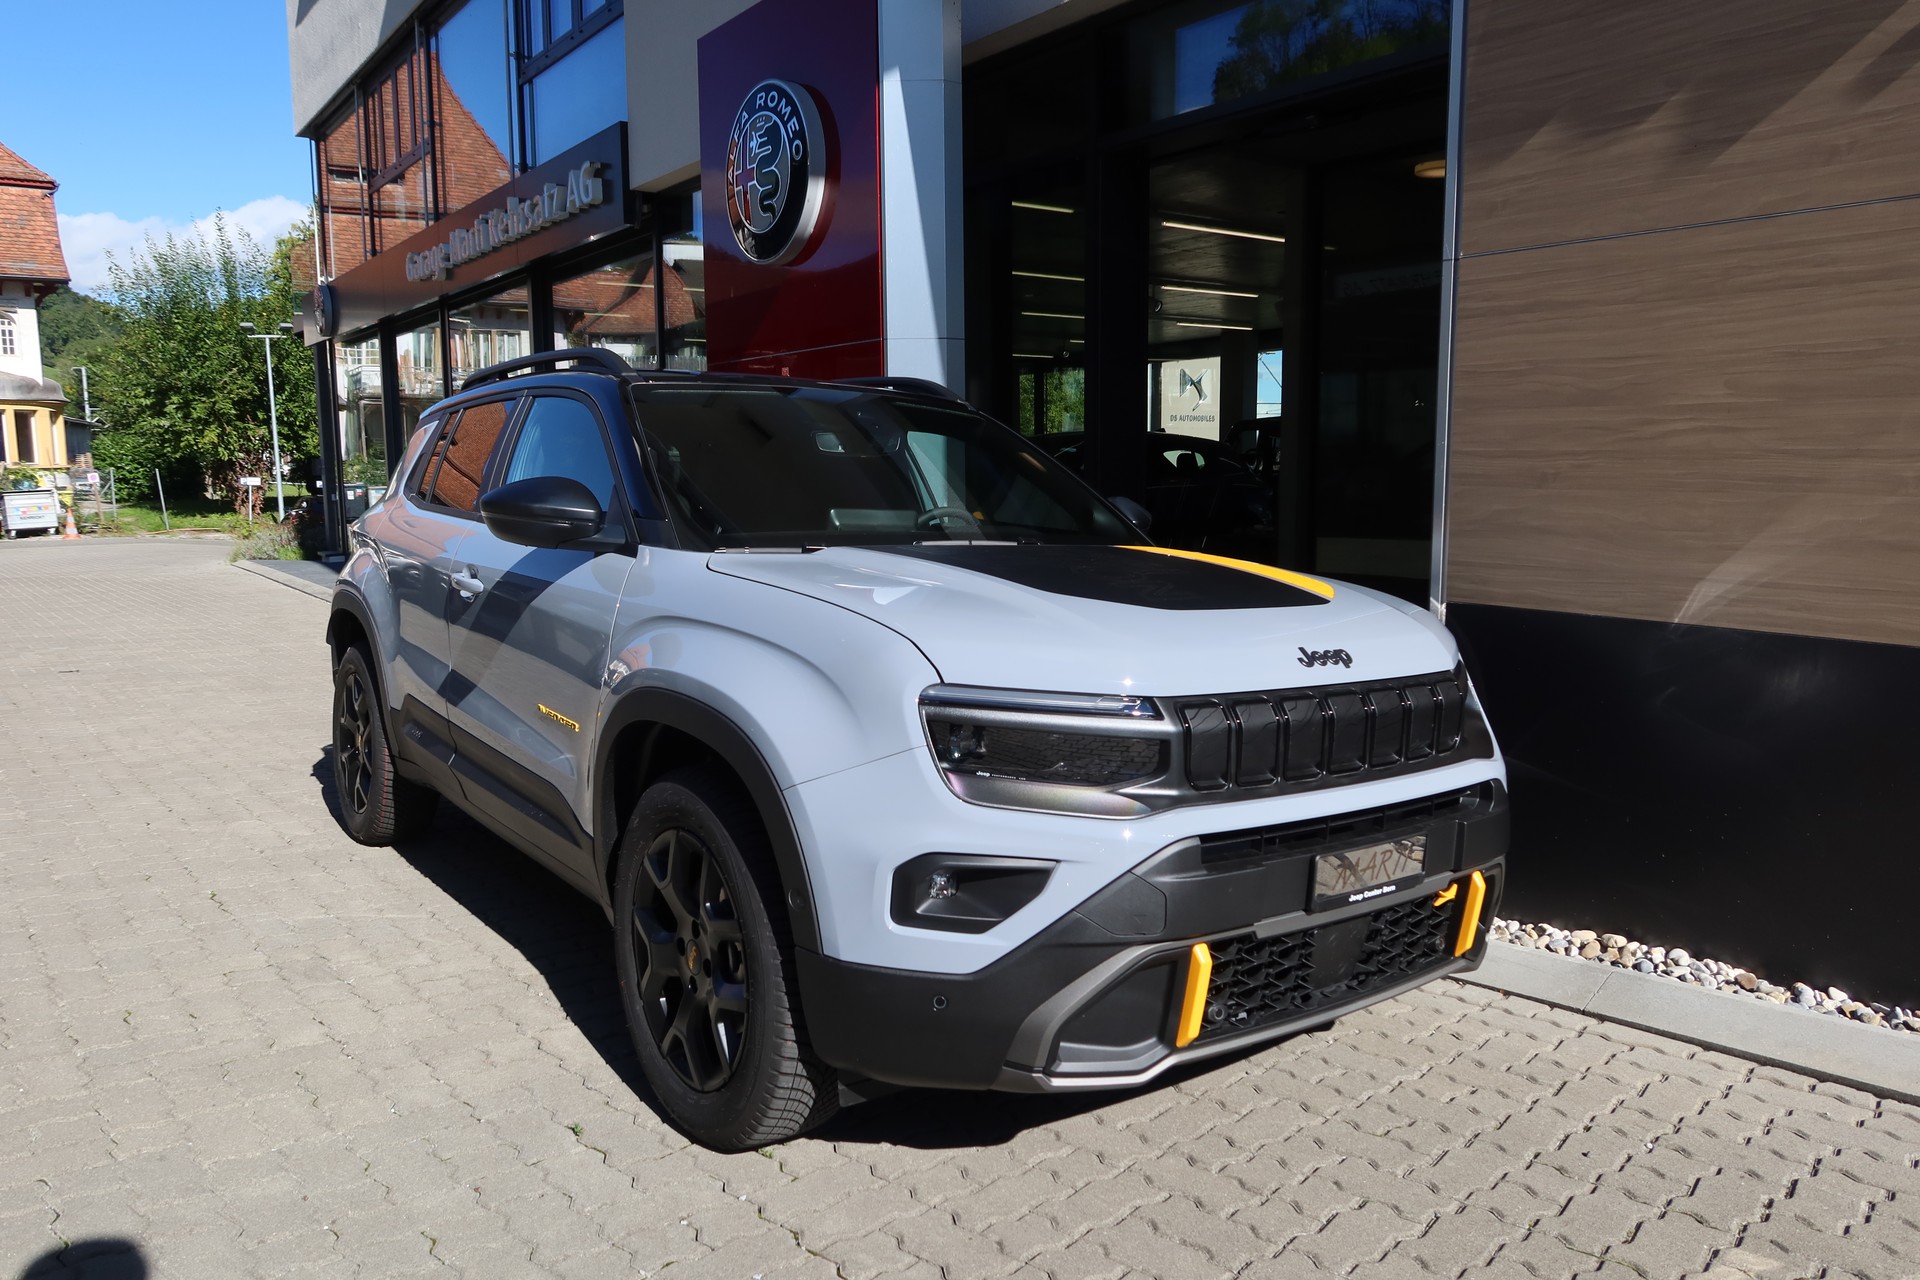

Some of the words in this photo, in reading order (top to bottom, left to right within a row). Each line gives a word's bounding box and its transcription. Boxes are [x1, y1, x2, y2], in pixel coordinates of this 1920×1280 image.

[727, 110, 749, 182] ALFA
[756, 91, 803, 161] ROMEO
[566, 160, 603, 213] AG
[1297, 646, 1354, 669] Jeep
